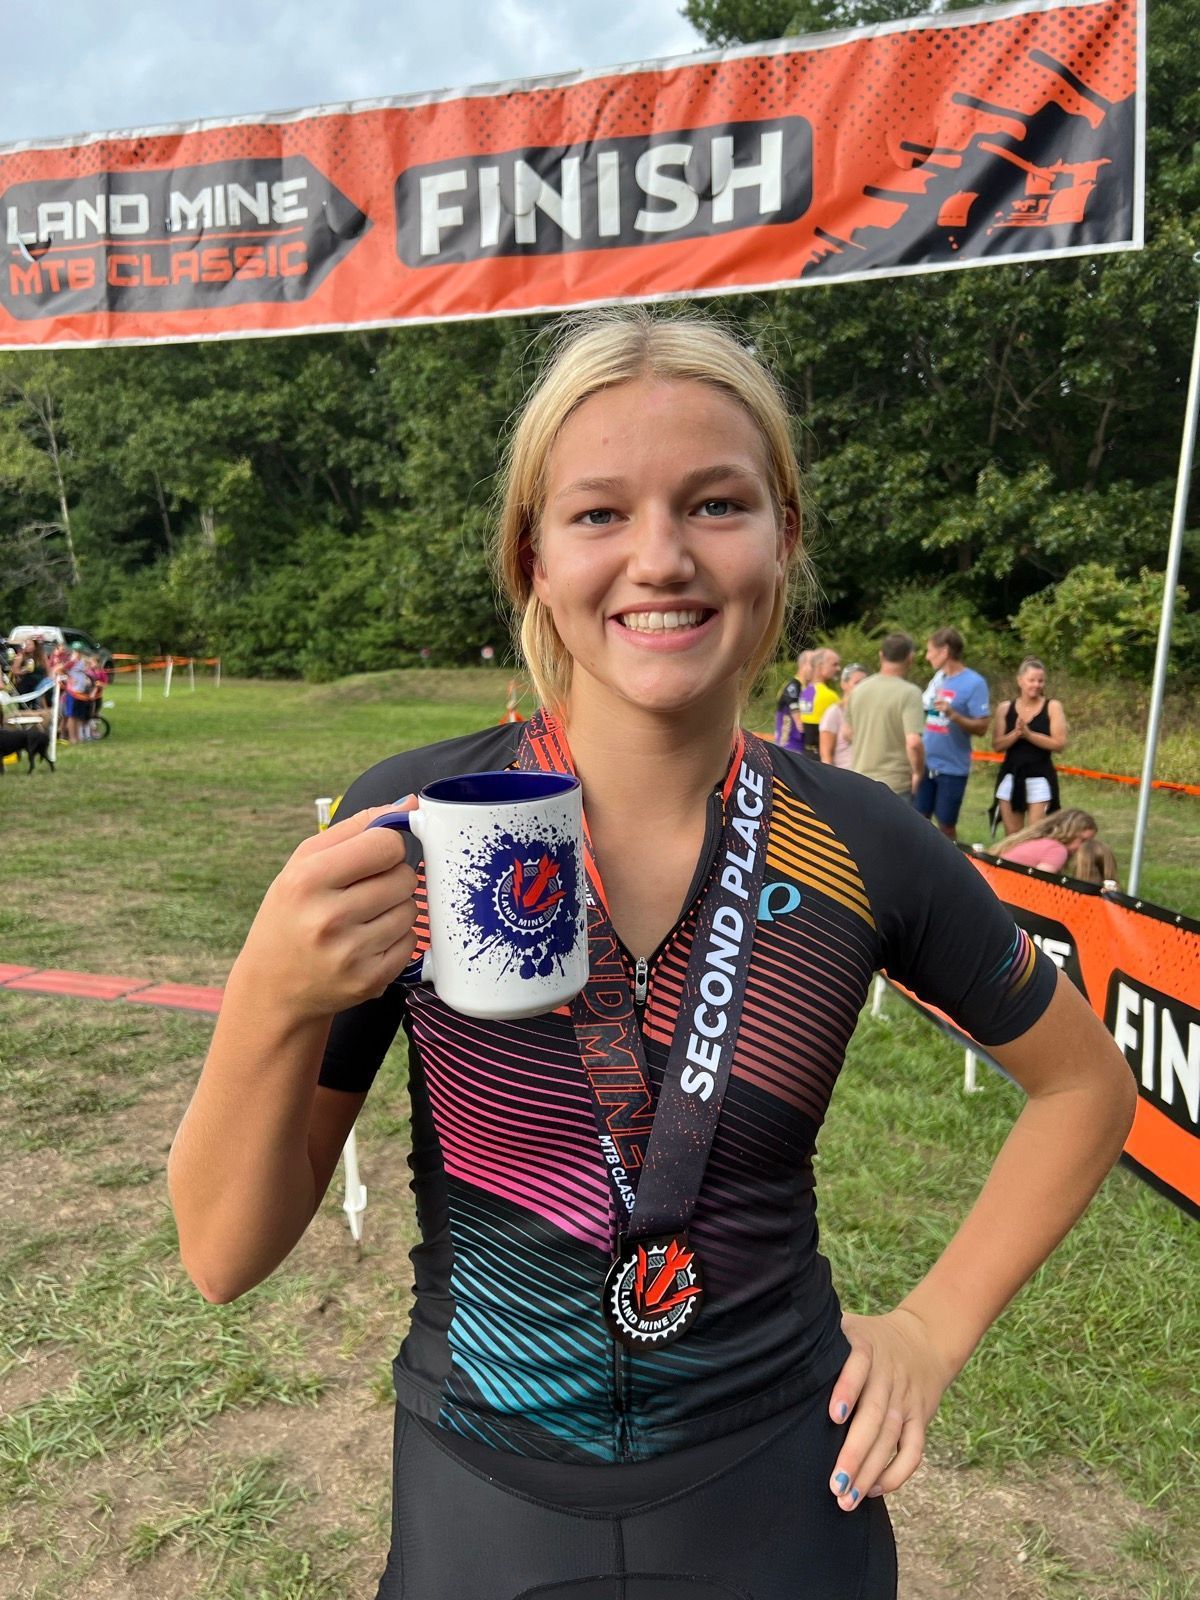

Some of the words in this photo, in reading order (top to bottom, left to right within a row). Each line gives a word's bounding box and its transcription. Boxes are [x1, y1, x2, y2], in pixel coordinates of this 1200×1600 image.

[7, 193, 150, 245] LAND
[170, 176, 309, 232] MINE
[419, 130, 783, 255] FINISH
[9, 257, 96, 296] MTB
[107, 241, 309, 288] CLASSIC
[501, 893, 517, 921] LAND
[518, 916, 545, 927] MINE
[680, 906, 743, 1102] SECOND
[720, 760, 764, 900] PLACE
[598, 1135, 621, 1164] MTB
[621, 1291, 638, 1325] LAND
[638, 1316, 670, 1331] MINE
